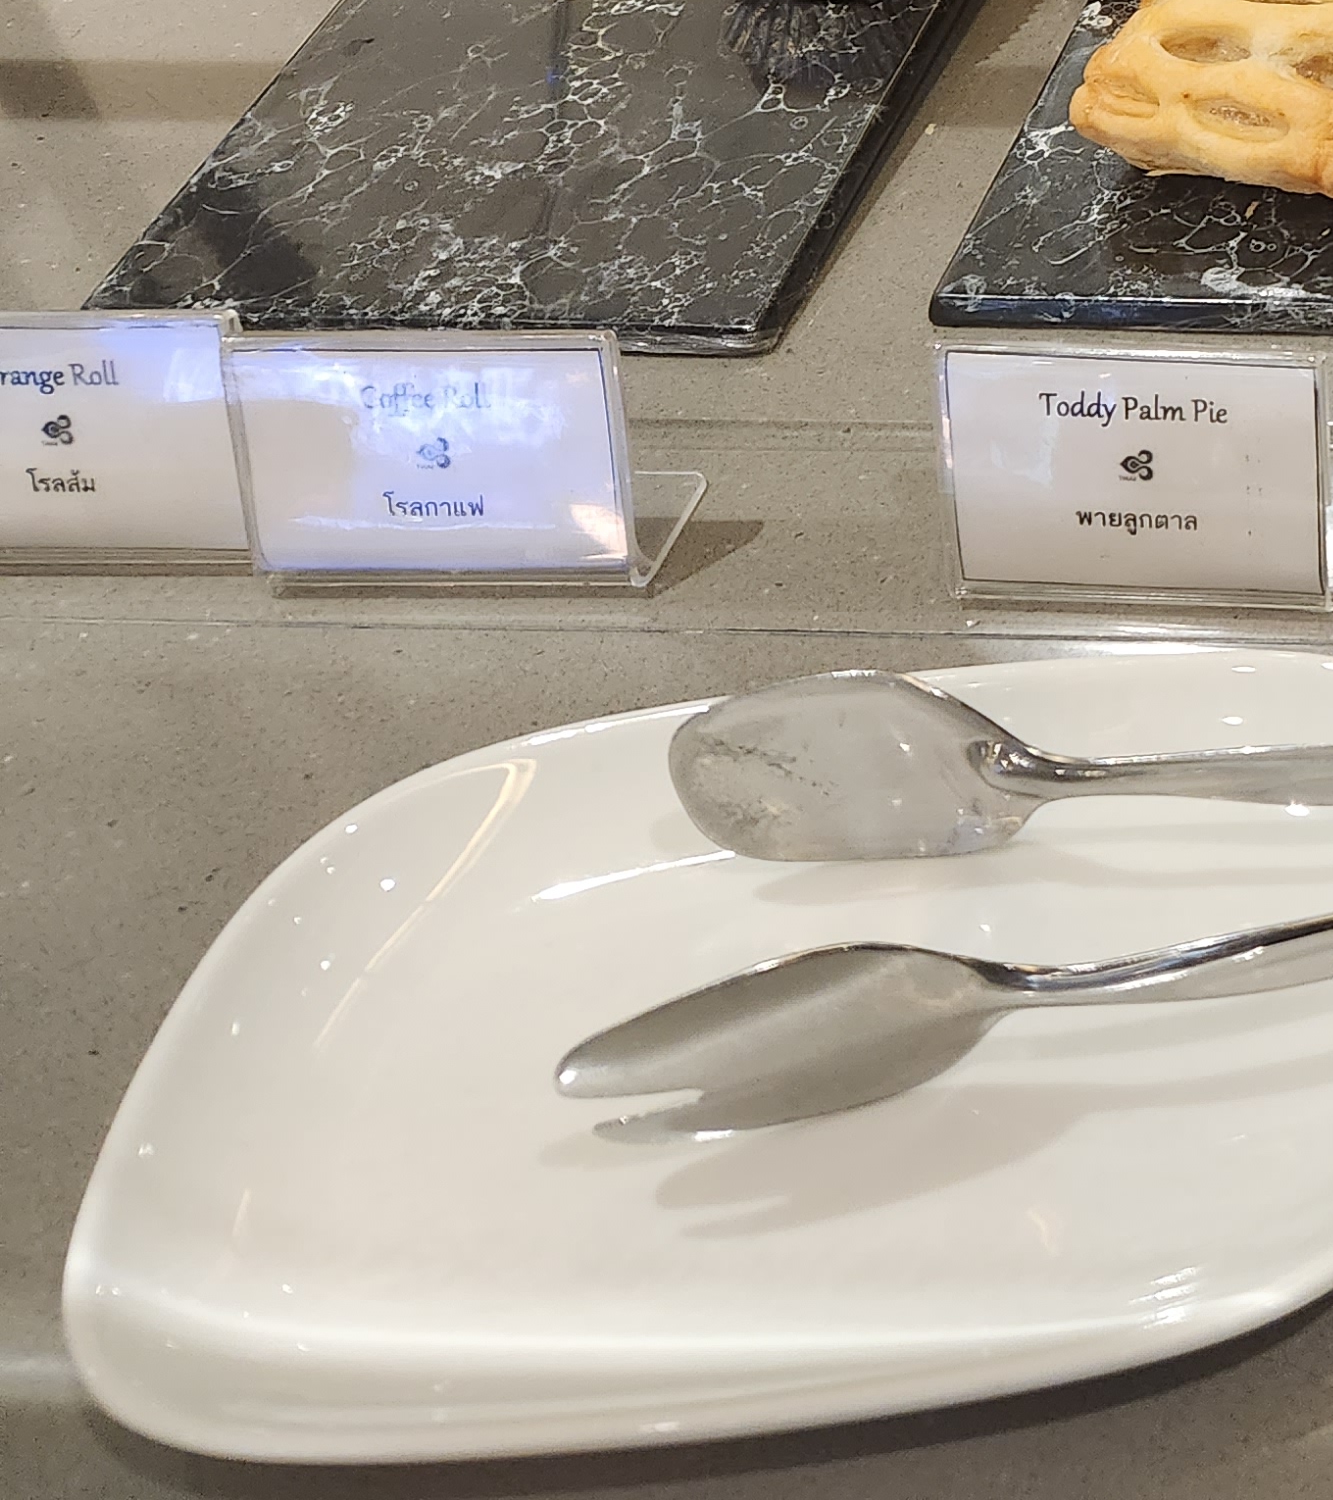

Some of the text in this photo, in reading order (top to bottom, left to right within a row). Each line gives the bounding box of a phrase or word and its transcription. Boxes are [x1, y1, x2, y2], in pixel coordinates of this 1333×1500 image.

[0, 360, 119, 395] range Roll
[1039, 390, 1228, 427] Toddy Palm Pie
[25, 467, 96, 493] โรลส้ม
[382, 490, 485, 517] โรลกาแฟ
[1075, 510, 1198, 536] พายลูกตาล
